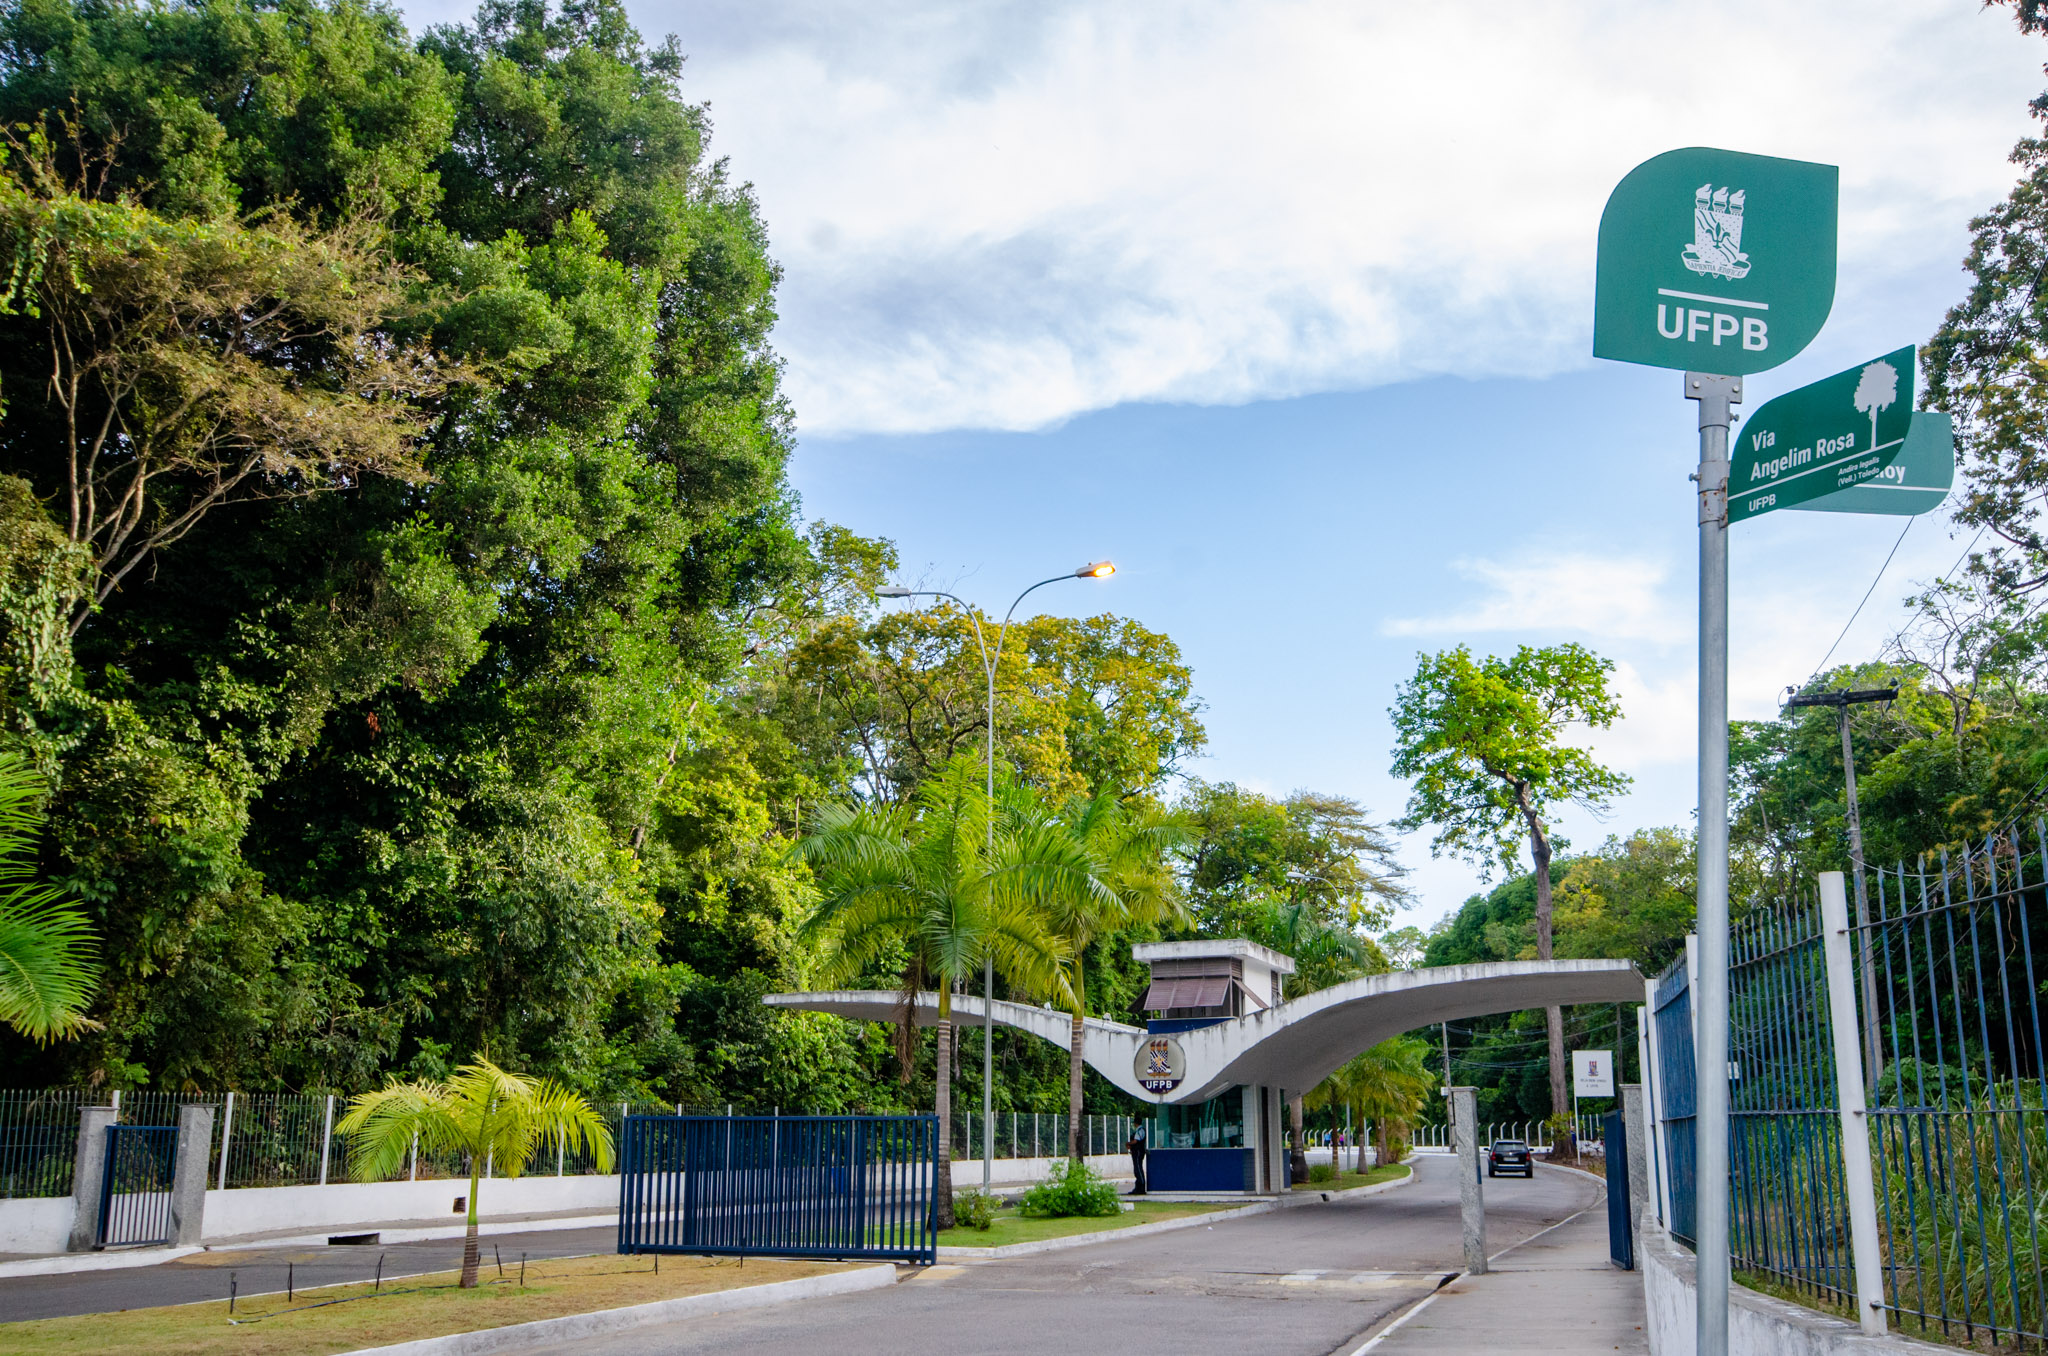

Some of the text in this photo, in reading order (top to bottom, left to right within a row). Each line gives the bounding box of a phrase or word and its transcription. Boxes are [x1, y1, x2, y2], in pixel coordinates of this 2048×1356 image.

[1657, 304, 1768, 351] UFPB
[1752, 430, 1775, 451] Via
[1750, 432, 1855, 481] Angelim Rosa
[1838, 464, 1858, 475] Andira
[1858, 467, 1880, 479] Toledo
[1749, 494, 1776, 512] UFPB
[1146, 1080, 1172, 1089] UFPB
